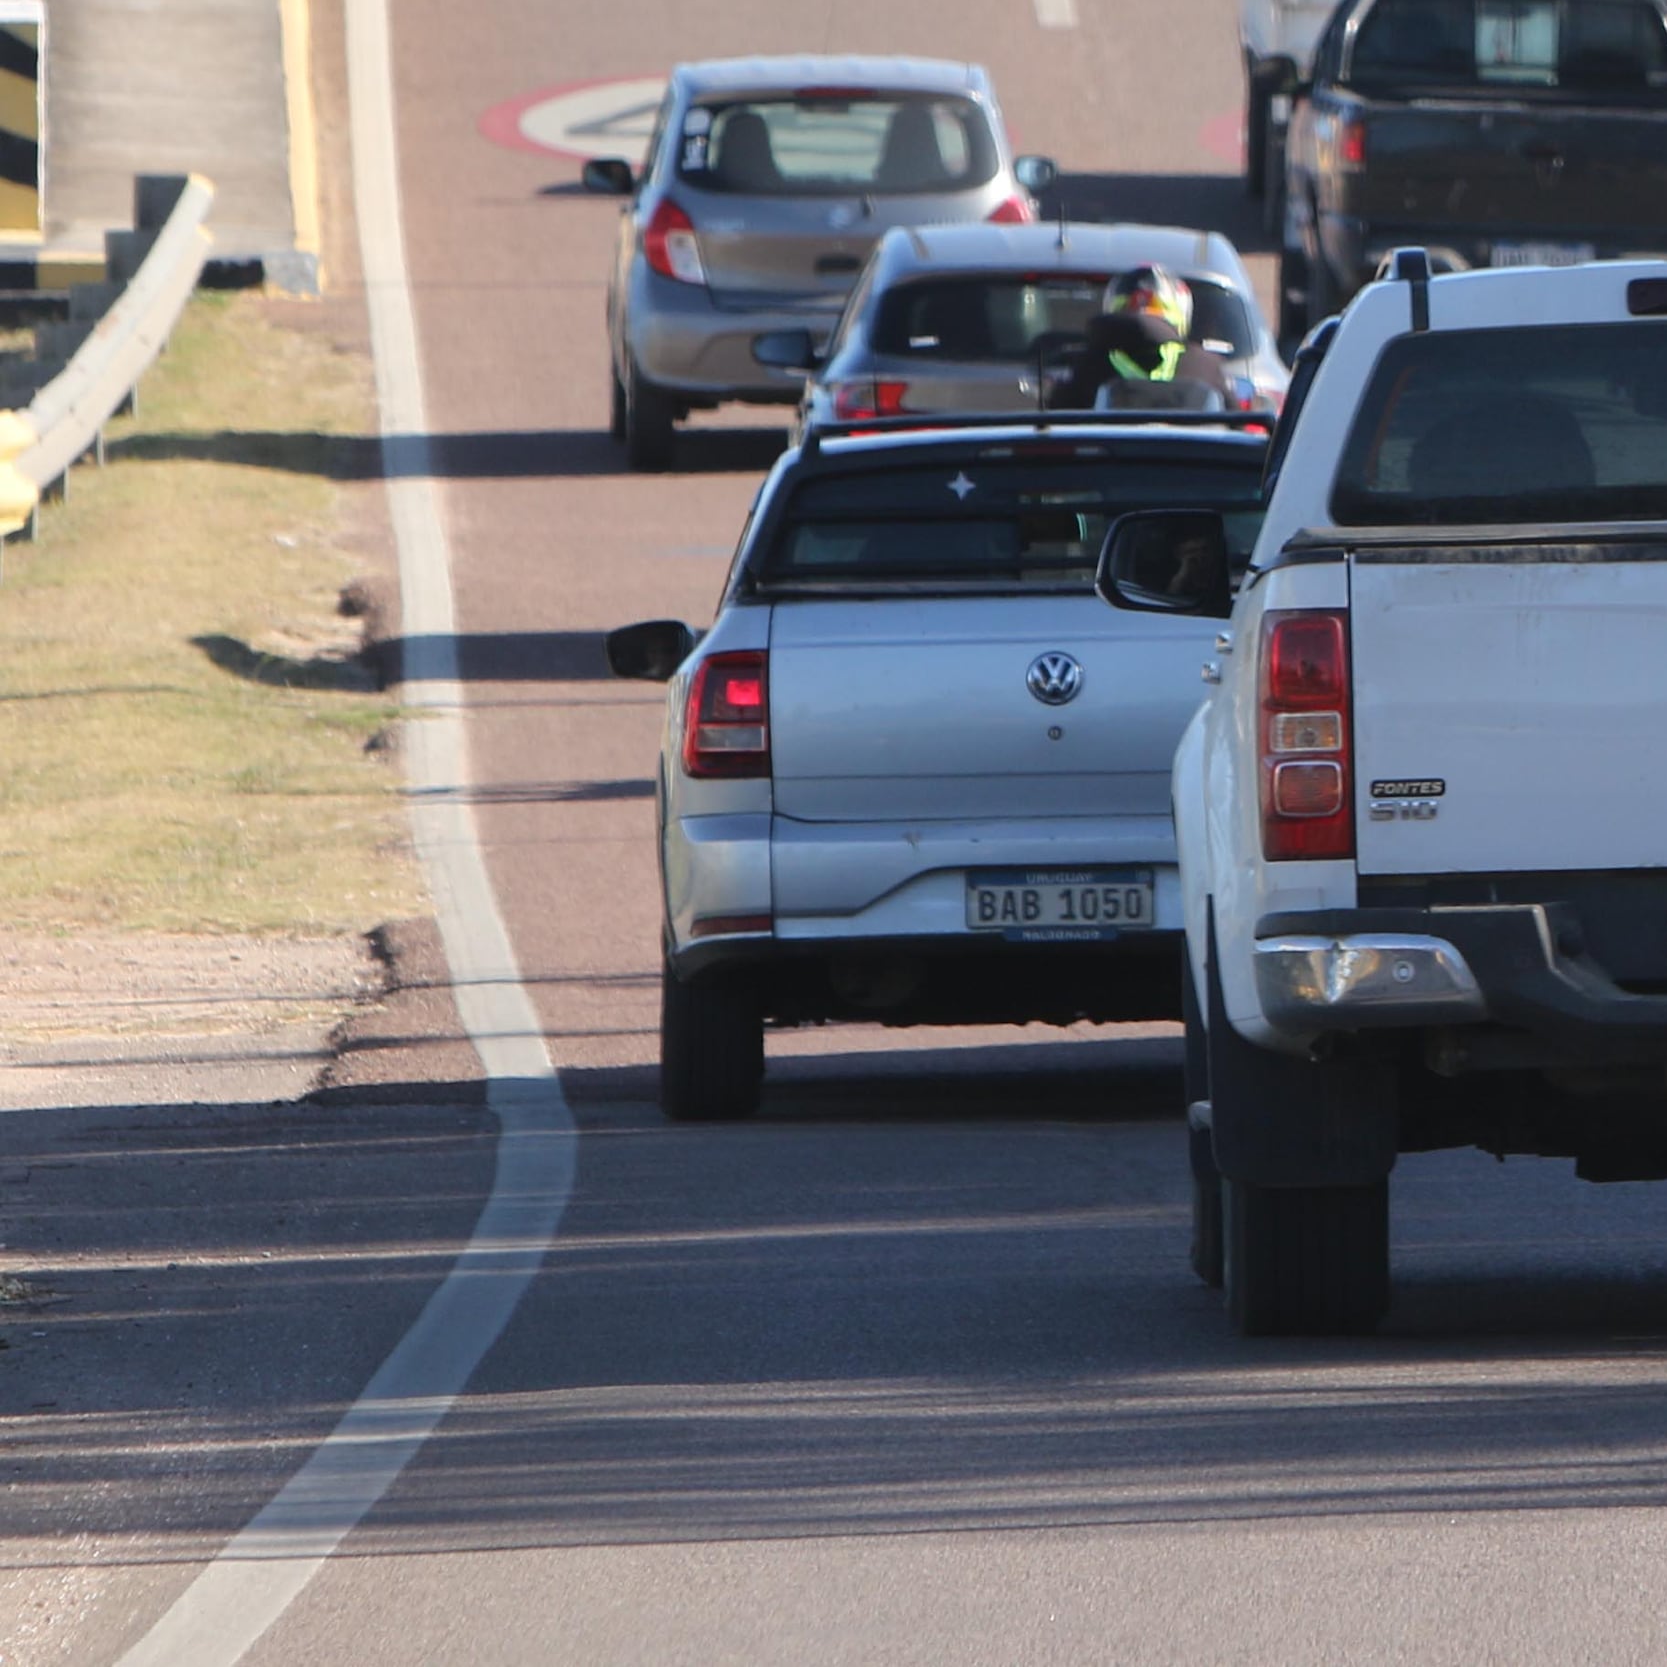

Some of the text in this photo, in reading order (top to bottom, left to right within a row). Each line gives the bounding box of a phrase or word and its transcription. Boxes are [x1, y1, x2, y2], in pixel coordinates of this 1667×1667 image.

[1373, 781, 1444, 795] FONTES
[978, 887, 1143, 922] BAB 1050
